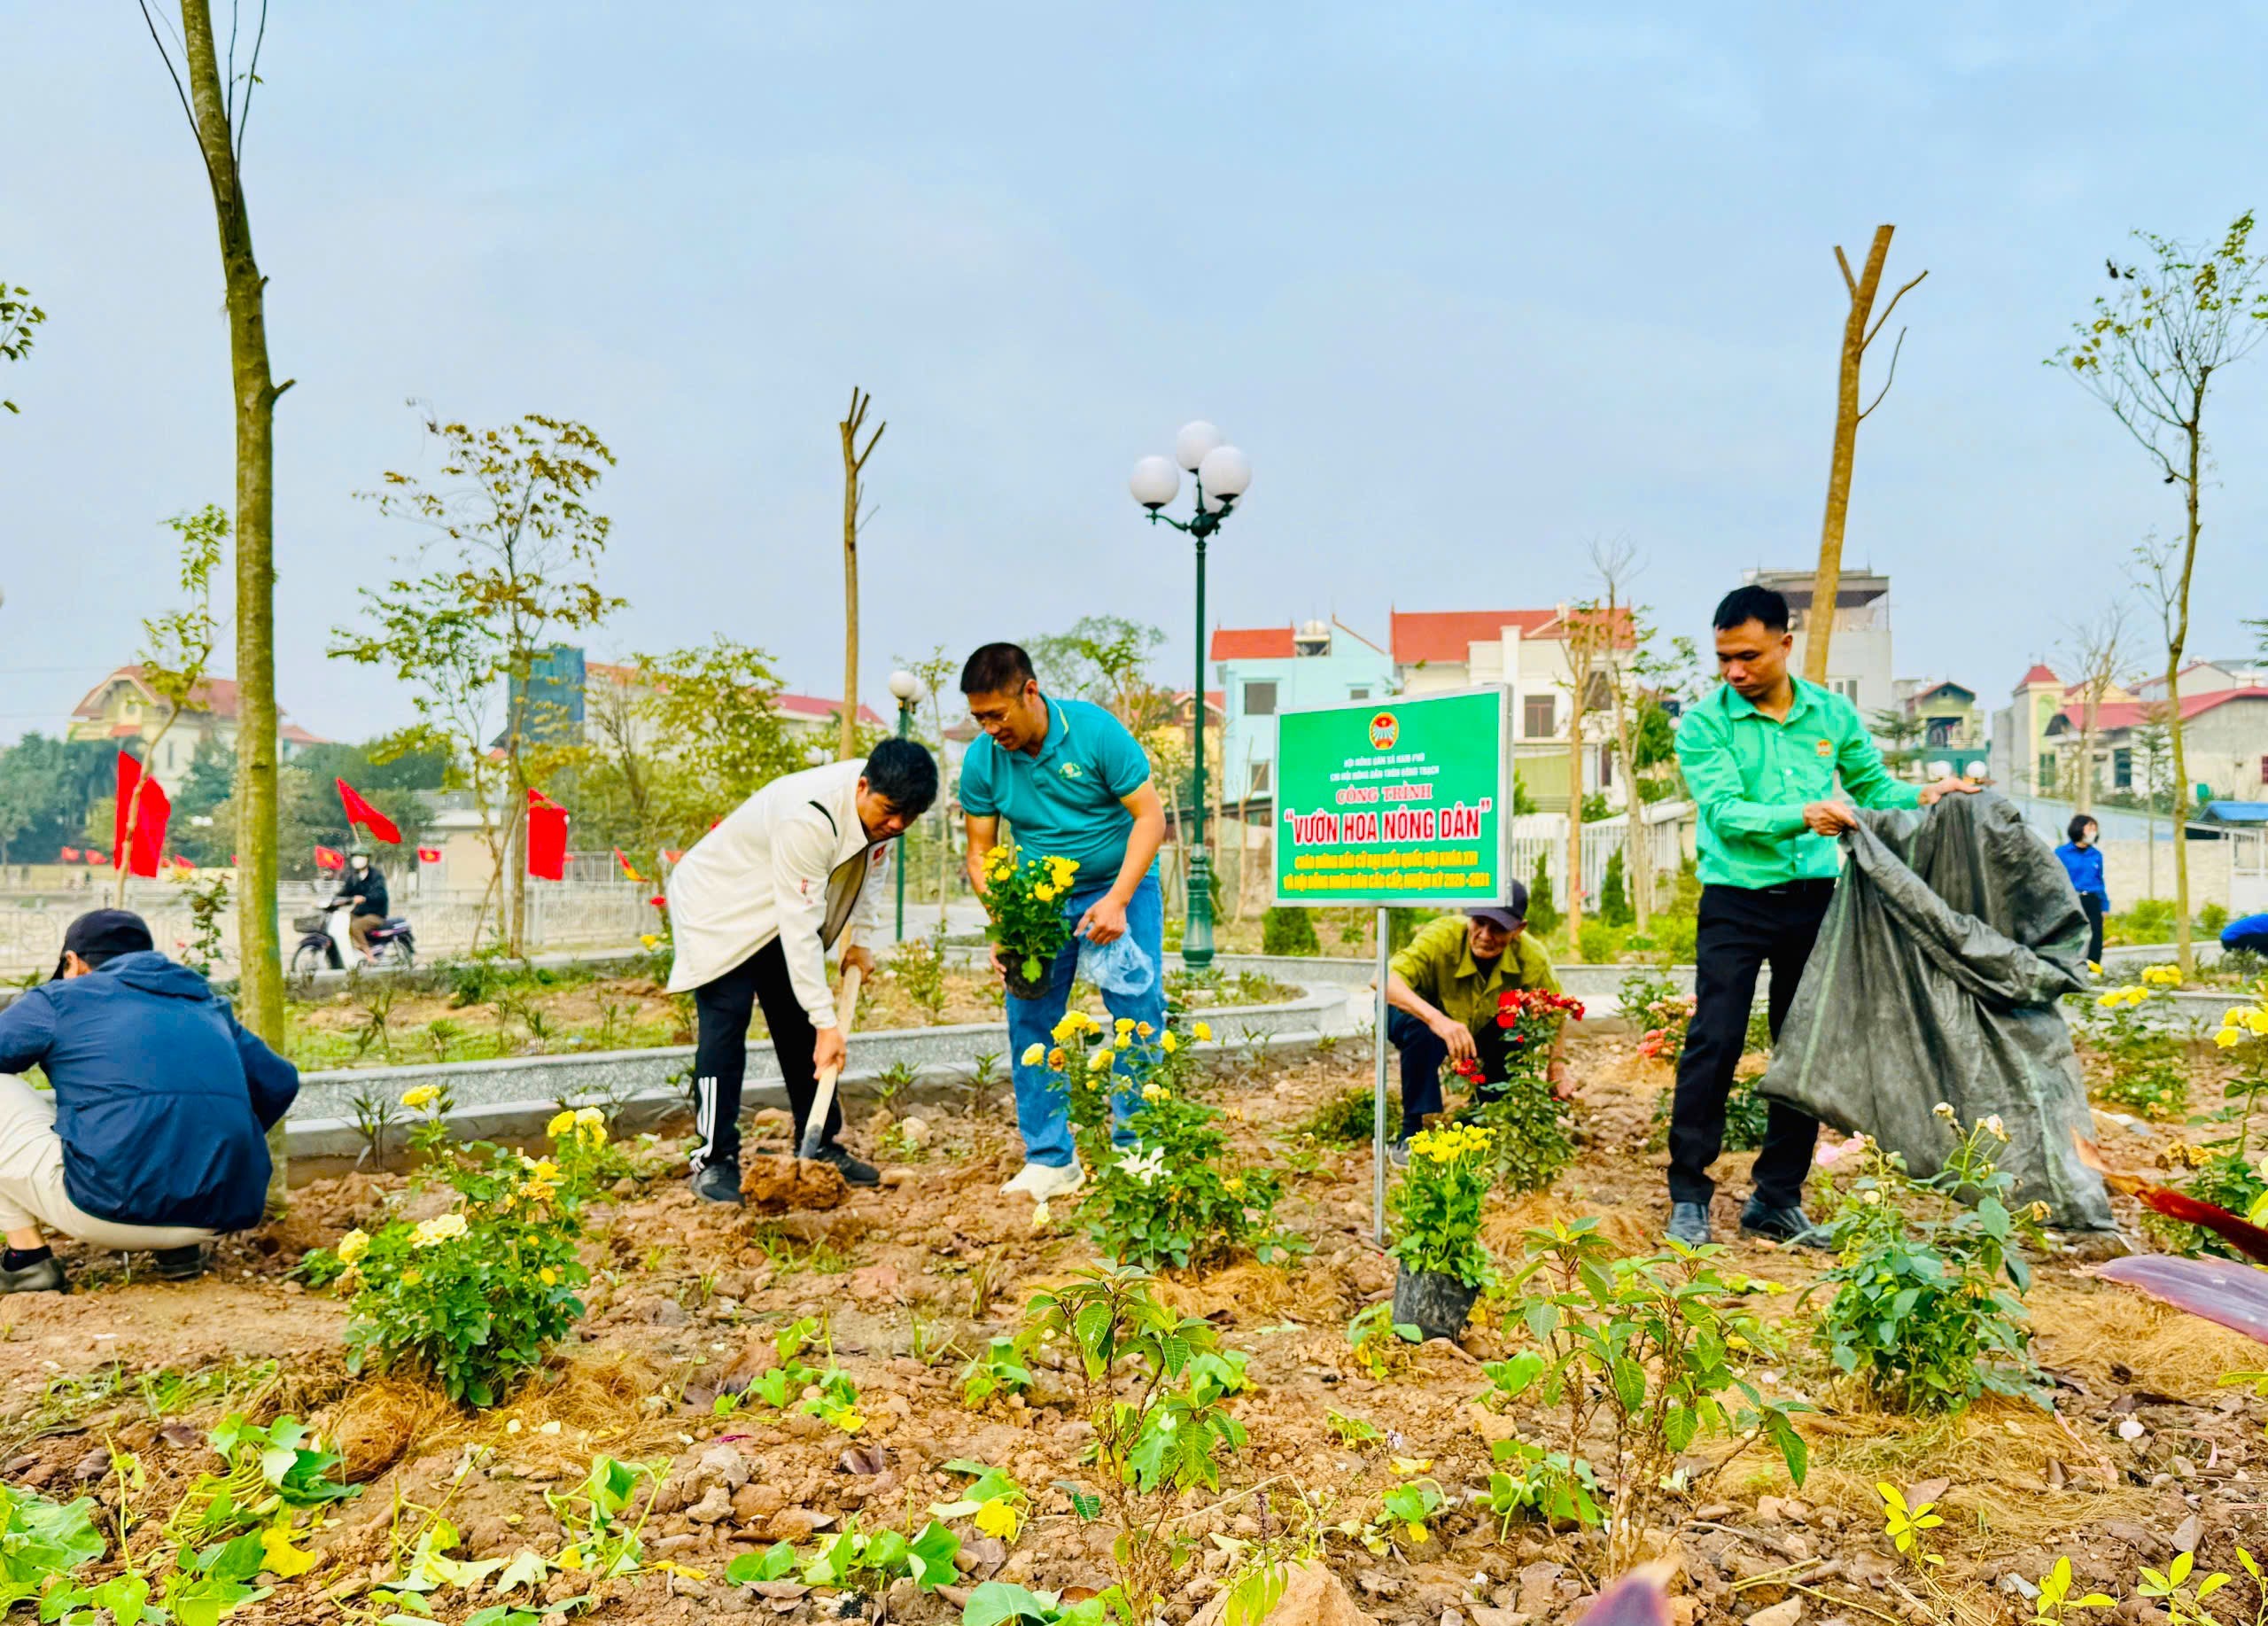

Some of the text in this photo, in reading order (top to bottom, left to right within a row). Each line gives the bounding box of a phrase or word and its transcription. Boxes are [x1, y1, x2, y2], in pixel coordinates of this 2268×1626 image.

[1336, 781, 1433, 805] CÔNG TRÌNH
[1343, 811, 1379, 843] HOA
[1382, 804, 1435, 841] NÔNG
